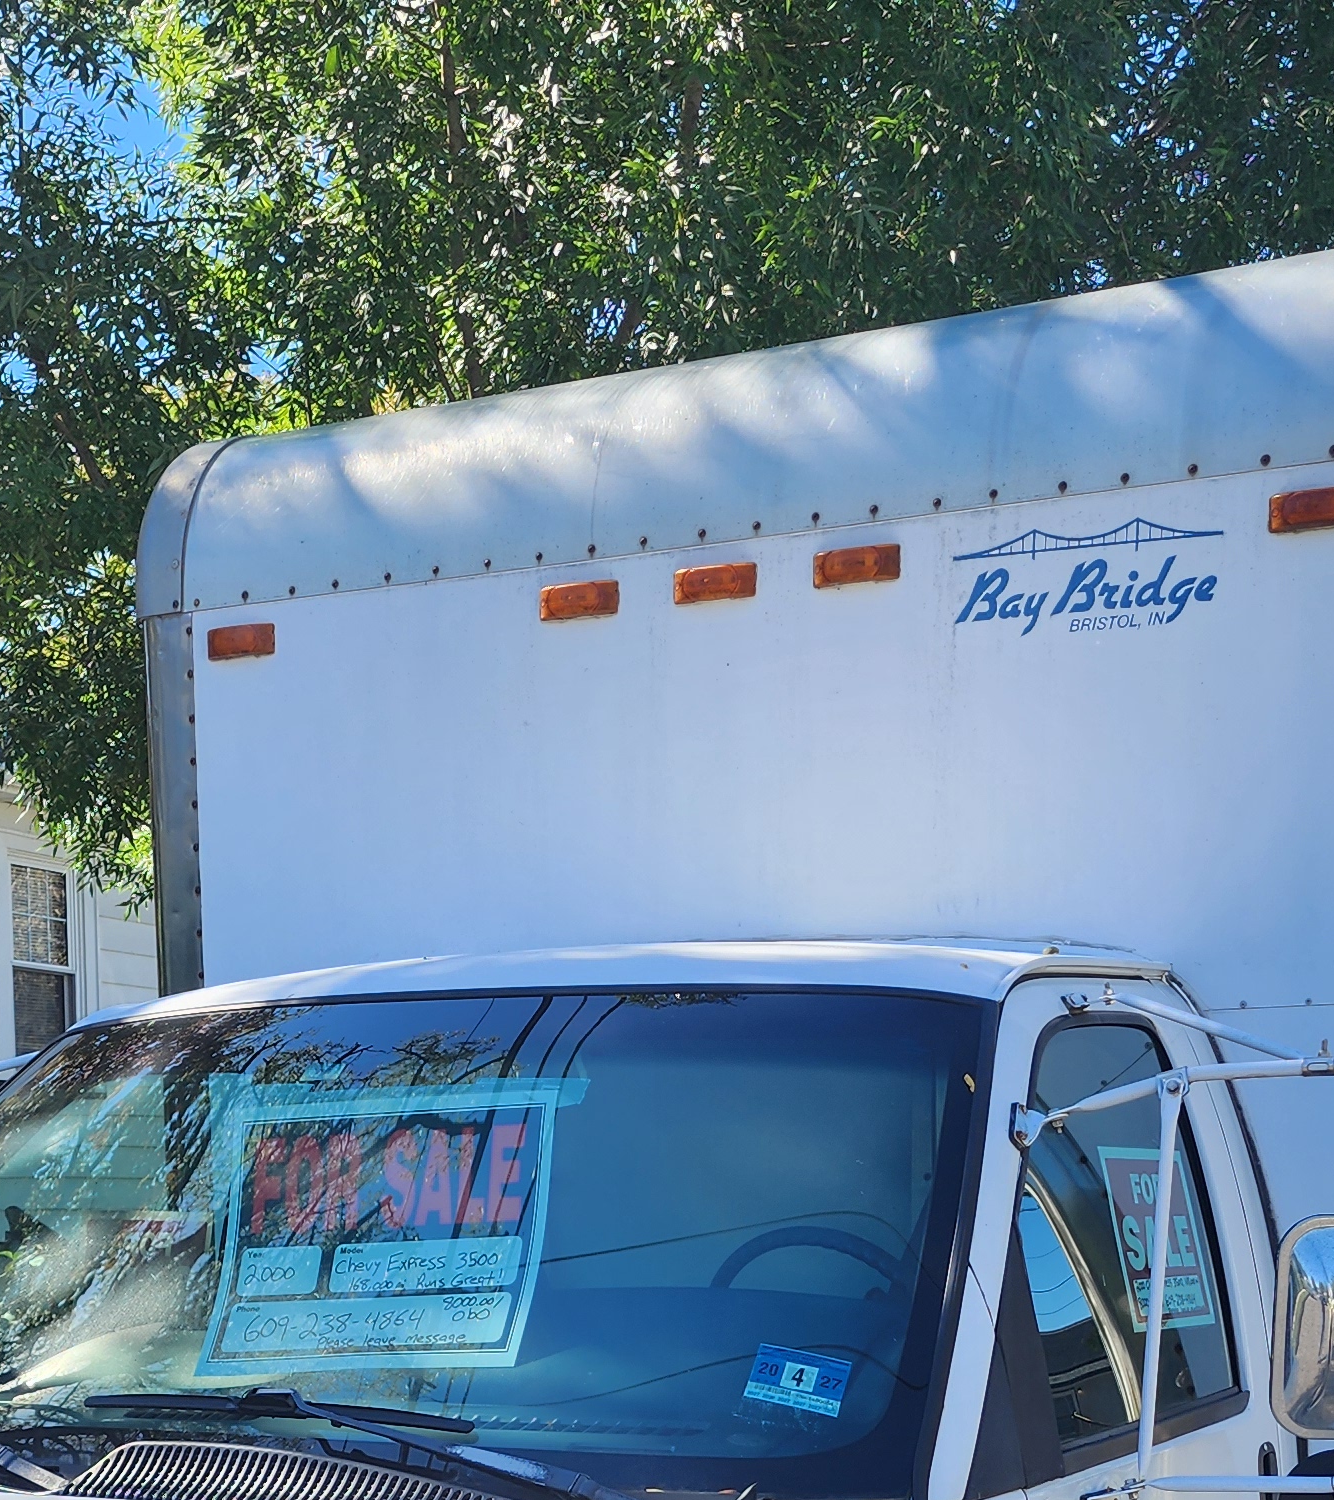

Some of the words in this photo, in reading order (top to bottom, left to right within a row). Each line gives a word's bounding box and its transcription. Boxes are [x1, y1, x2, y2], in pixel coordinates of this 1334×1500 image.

[955, 568, 1049, 637] Bay
[1050, 555, 1218, 624] Bridge
[1069, 614, 1141, 632] BRISTOL,
[1148, 611, 1166, 626] IN
[251, 1133, 362, 1235] FOR
[380, 1123, 528, 1229] SALE
[247, 1251, 264, 1259] Yea
[335, 1257, 382, 1277] Chevy
[455, 1251, 499, 1271] 3500
[244, 1264, 296, 1286] 2000
[416, 1272, 446, 1289] Runs
[236, 1305, 261, 1313] Phone
[244, 1309, 426, 1343] 609-238-4864
[363, 1334, 395, 1347] leave
[758, 1361, 779, 1377] 20
[791, 1368, 805, 1388] 4
[819, 1375, 842, 1391] 27
